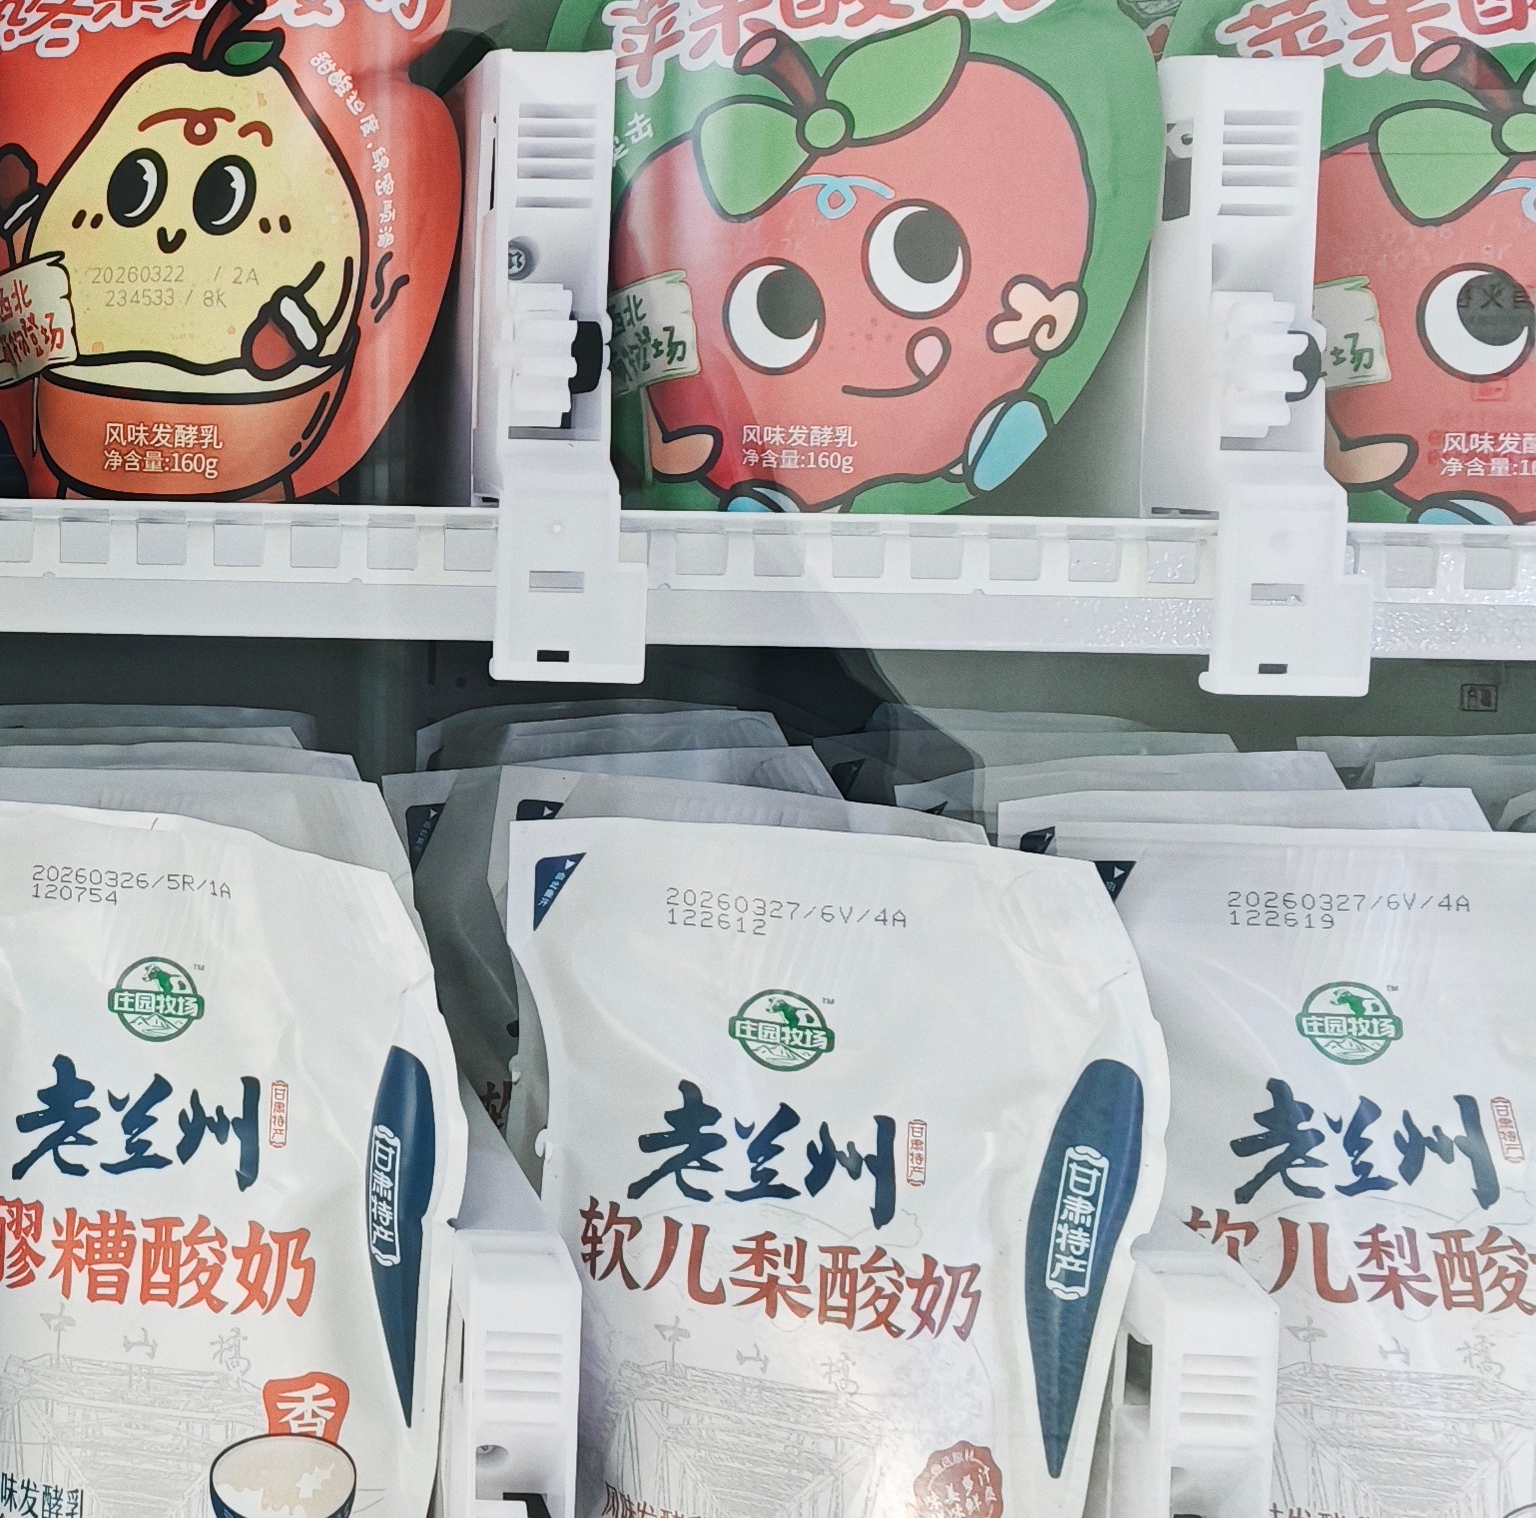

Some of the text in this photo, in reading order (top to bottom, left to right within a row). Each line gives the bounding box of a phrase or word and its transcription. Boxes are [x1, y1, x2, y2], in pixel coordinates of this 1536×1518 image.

[91, 265, 260, 286] 20260322 2A
[105, 289, 228, 309] 234533 8K
[104, 423, 223, 450] 风味发酵乳
[741, 424, 859, 449] 风味发酵乳
[103, 449, 219, 479] 净含量:160g
[741, 449, 855, 474] 净含量:160g
[31, 864, 233, 901] 20260326/5R/1A
[31, 884, 119, 907] 120754
[666, 887, 908, 929] 20260327/6V/4A
[1227, 890, 1471, 914] 20260327/6V/4A
[666, 908, 768, 938] 122612
[1229, 910, 1335, 929] 122619
[112, 991, 201, 1019] 庄园牧场
[734, 1018, 830, 1051] 庄园牧场
[1302, 1015, 1395, 1039] 庄园牧场
[11, 1053, 262, 1190] 老兰州
[627, 1080, 898, 1230] 老兰州
[1229, 1077, 1500, 1210] 老兰州
[370, 1141, 397, 1261] 甘肃特产
[1050, 1159, 1105, 1282] 甘肃特产
[579, 1195, 982, 1343] 软儿梨酸奶
[274, 1382, 336, 1436] 香
